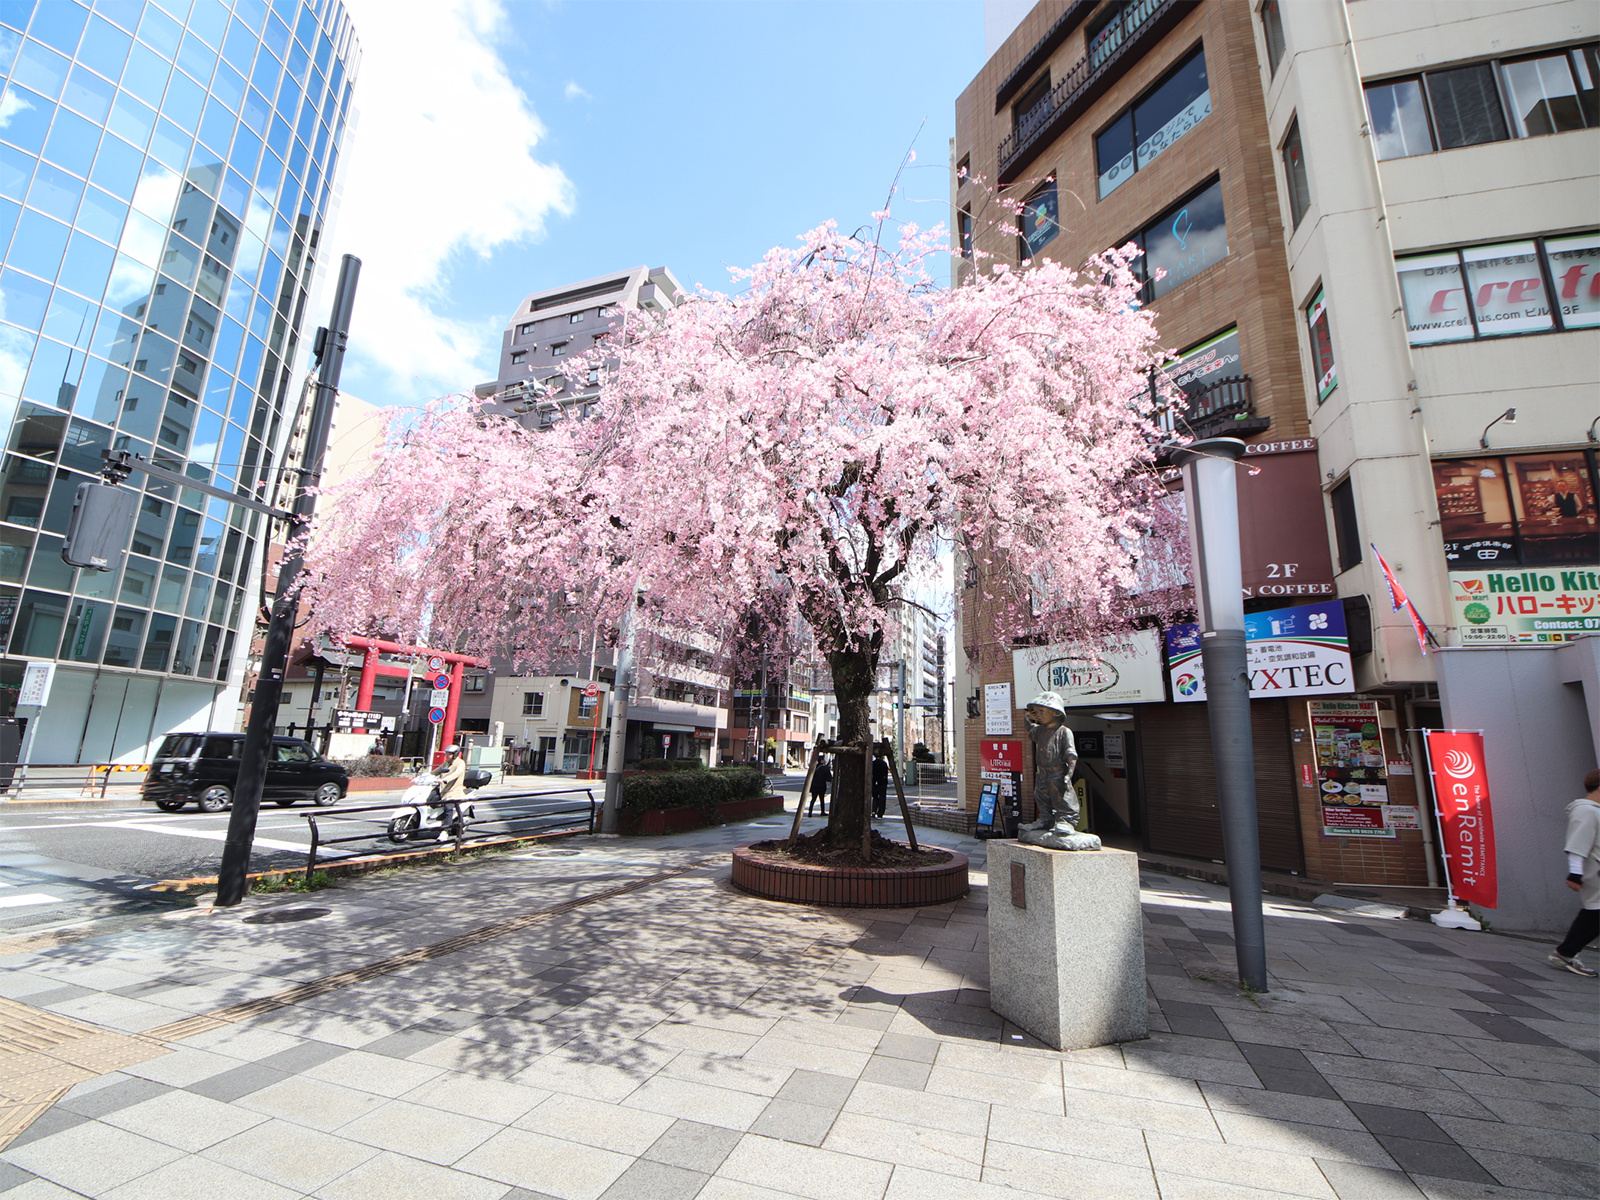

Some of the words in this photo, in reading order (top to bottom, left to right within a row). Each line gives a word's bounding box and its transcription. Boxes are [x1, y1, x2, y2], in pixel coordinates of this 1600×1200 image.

[1148, 104, 1211, 161] あなたらしく
[1168, 246, 1207, 276] TAKT
[1562, 304, 1580, 316] 3F
[1245, 439, 1315, 454] COFFEE
[1444, 542, 1460, 551] 2F
[1266, 563, 1299, 579] 2F
[1242, 586, 1253, 597] N
[1258, 583, 1333, 596] COFFEE
[1488, 573, 1555, 593] Hello
[1497, 594, 1600, 615] ハローキッ
[1534, 619, 1583, 630] Contact:
[1248, 651, 1316, 663] ーム・空気調和設備
[1249, 662, 1346, 690] YXTEC
[1322, 702, 1337, 710] Hello
[1337, 702, 1359, 710] Kitchen
[1359, 702, 1375, 710] MART
[1473, 784, 1481, 794] The
[1453, 783, 1479, 887] enRemit
